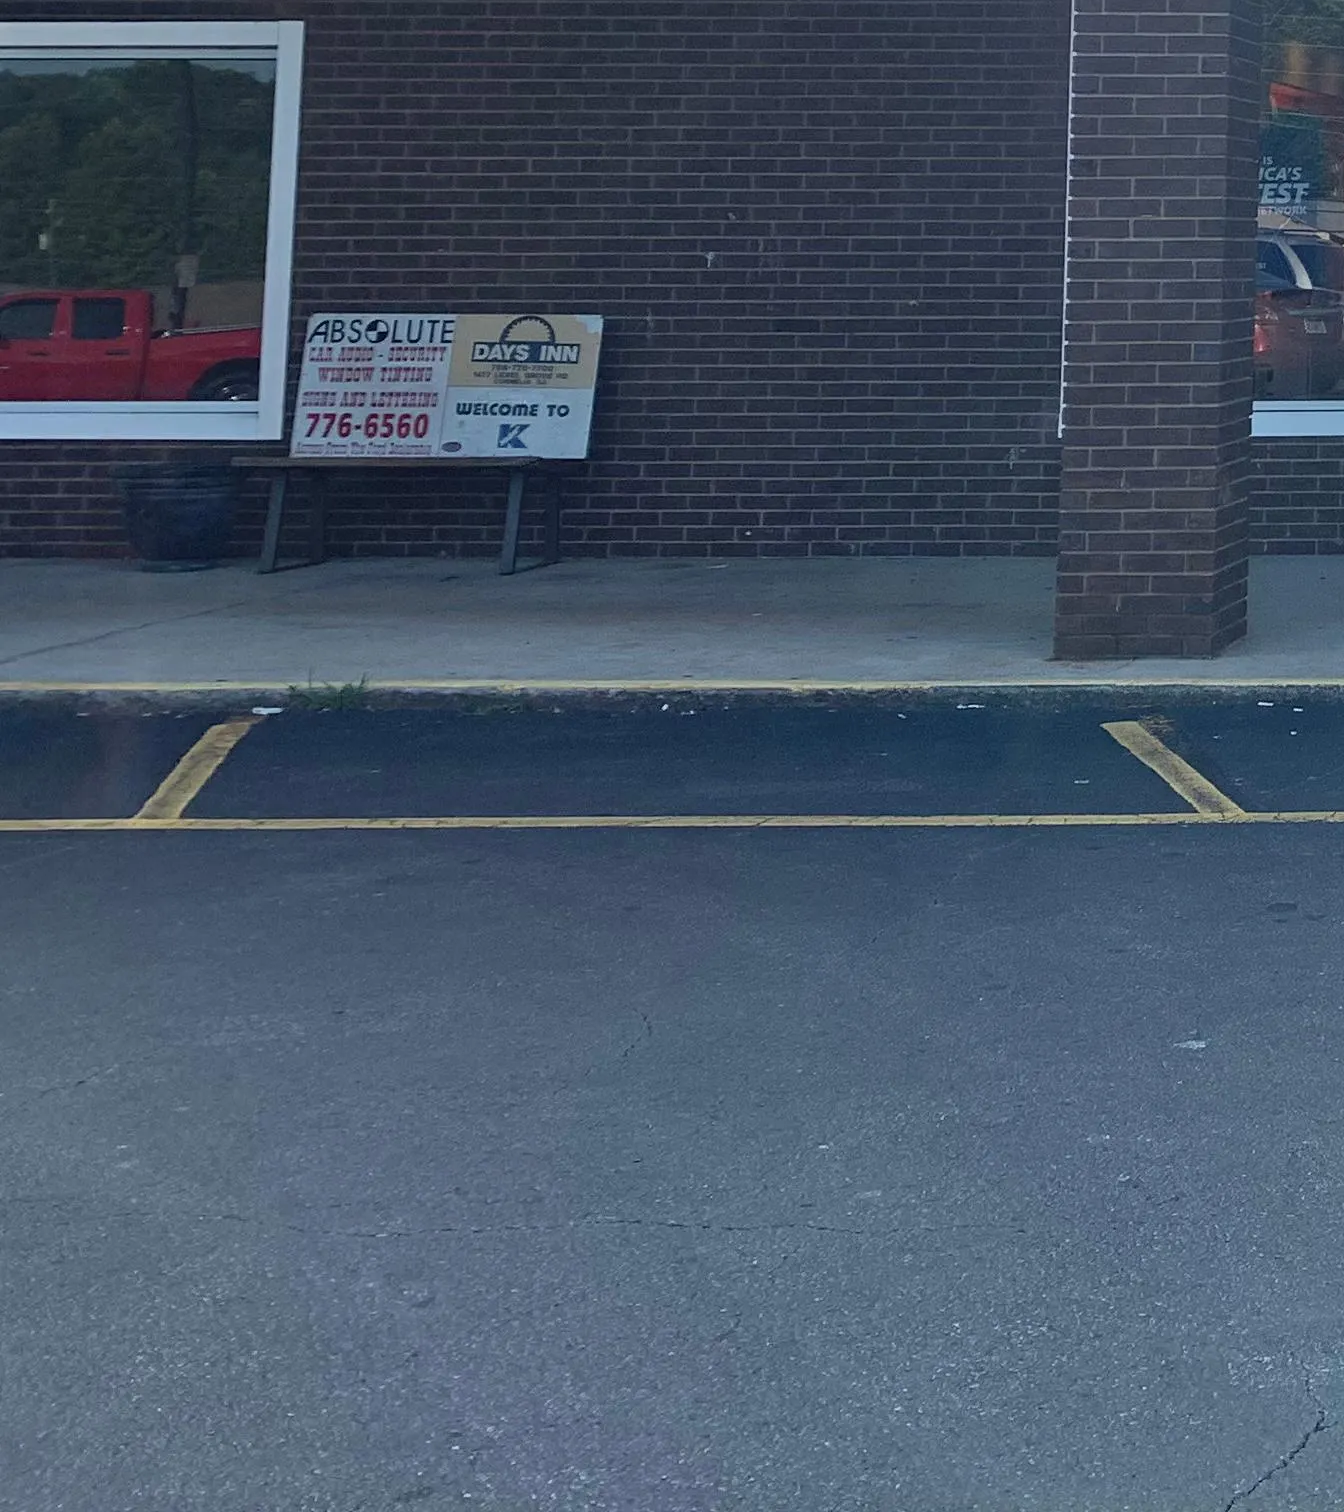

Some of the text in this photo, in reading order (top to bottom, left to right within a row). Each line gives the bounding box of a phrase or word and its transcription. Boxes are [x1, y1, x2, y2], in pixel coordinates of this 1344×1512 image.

[473, 343, 579, 363] DAYS INN
[318, 366, 376, 383] WINDOW
[455, 402, 570, 418] WELCOME TO
[304, 412, 430, 439] 776-6560
[497, 423, 531, 449] K
